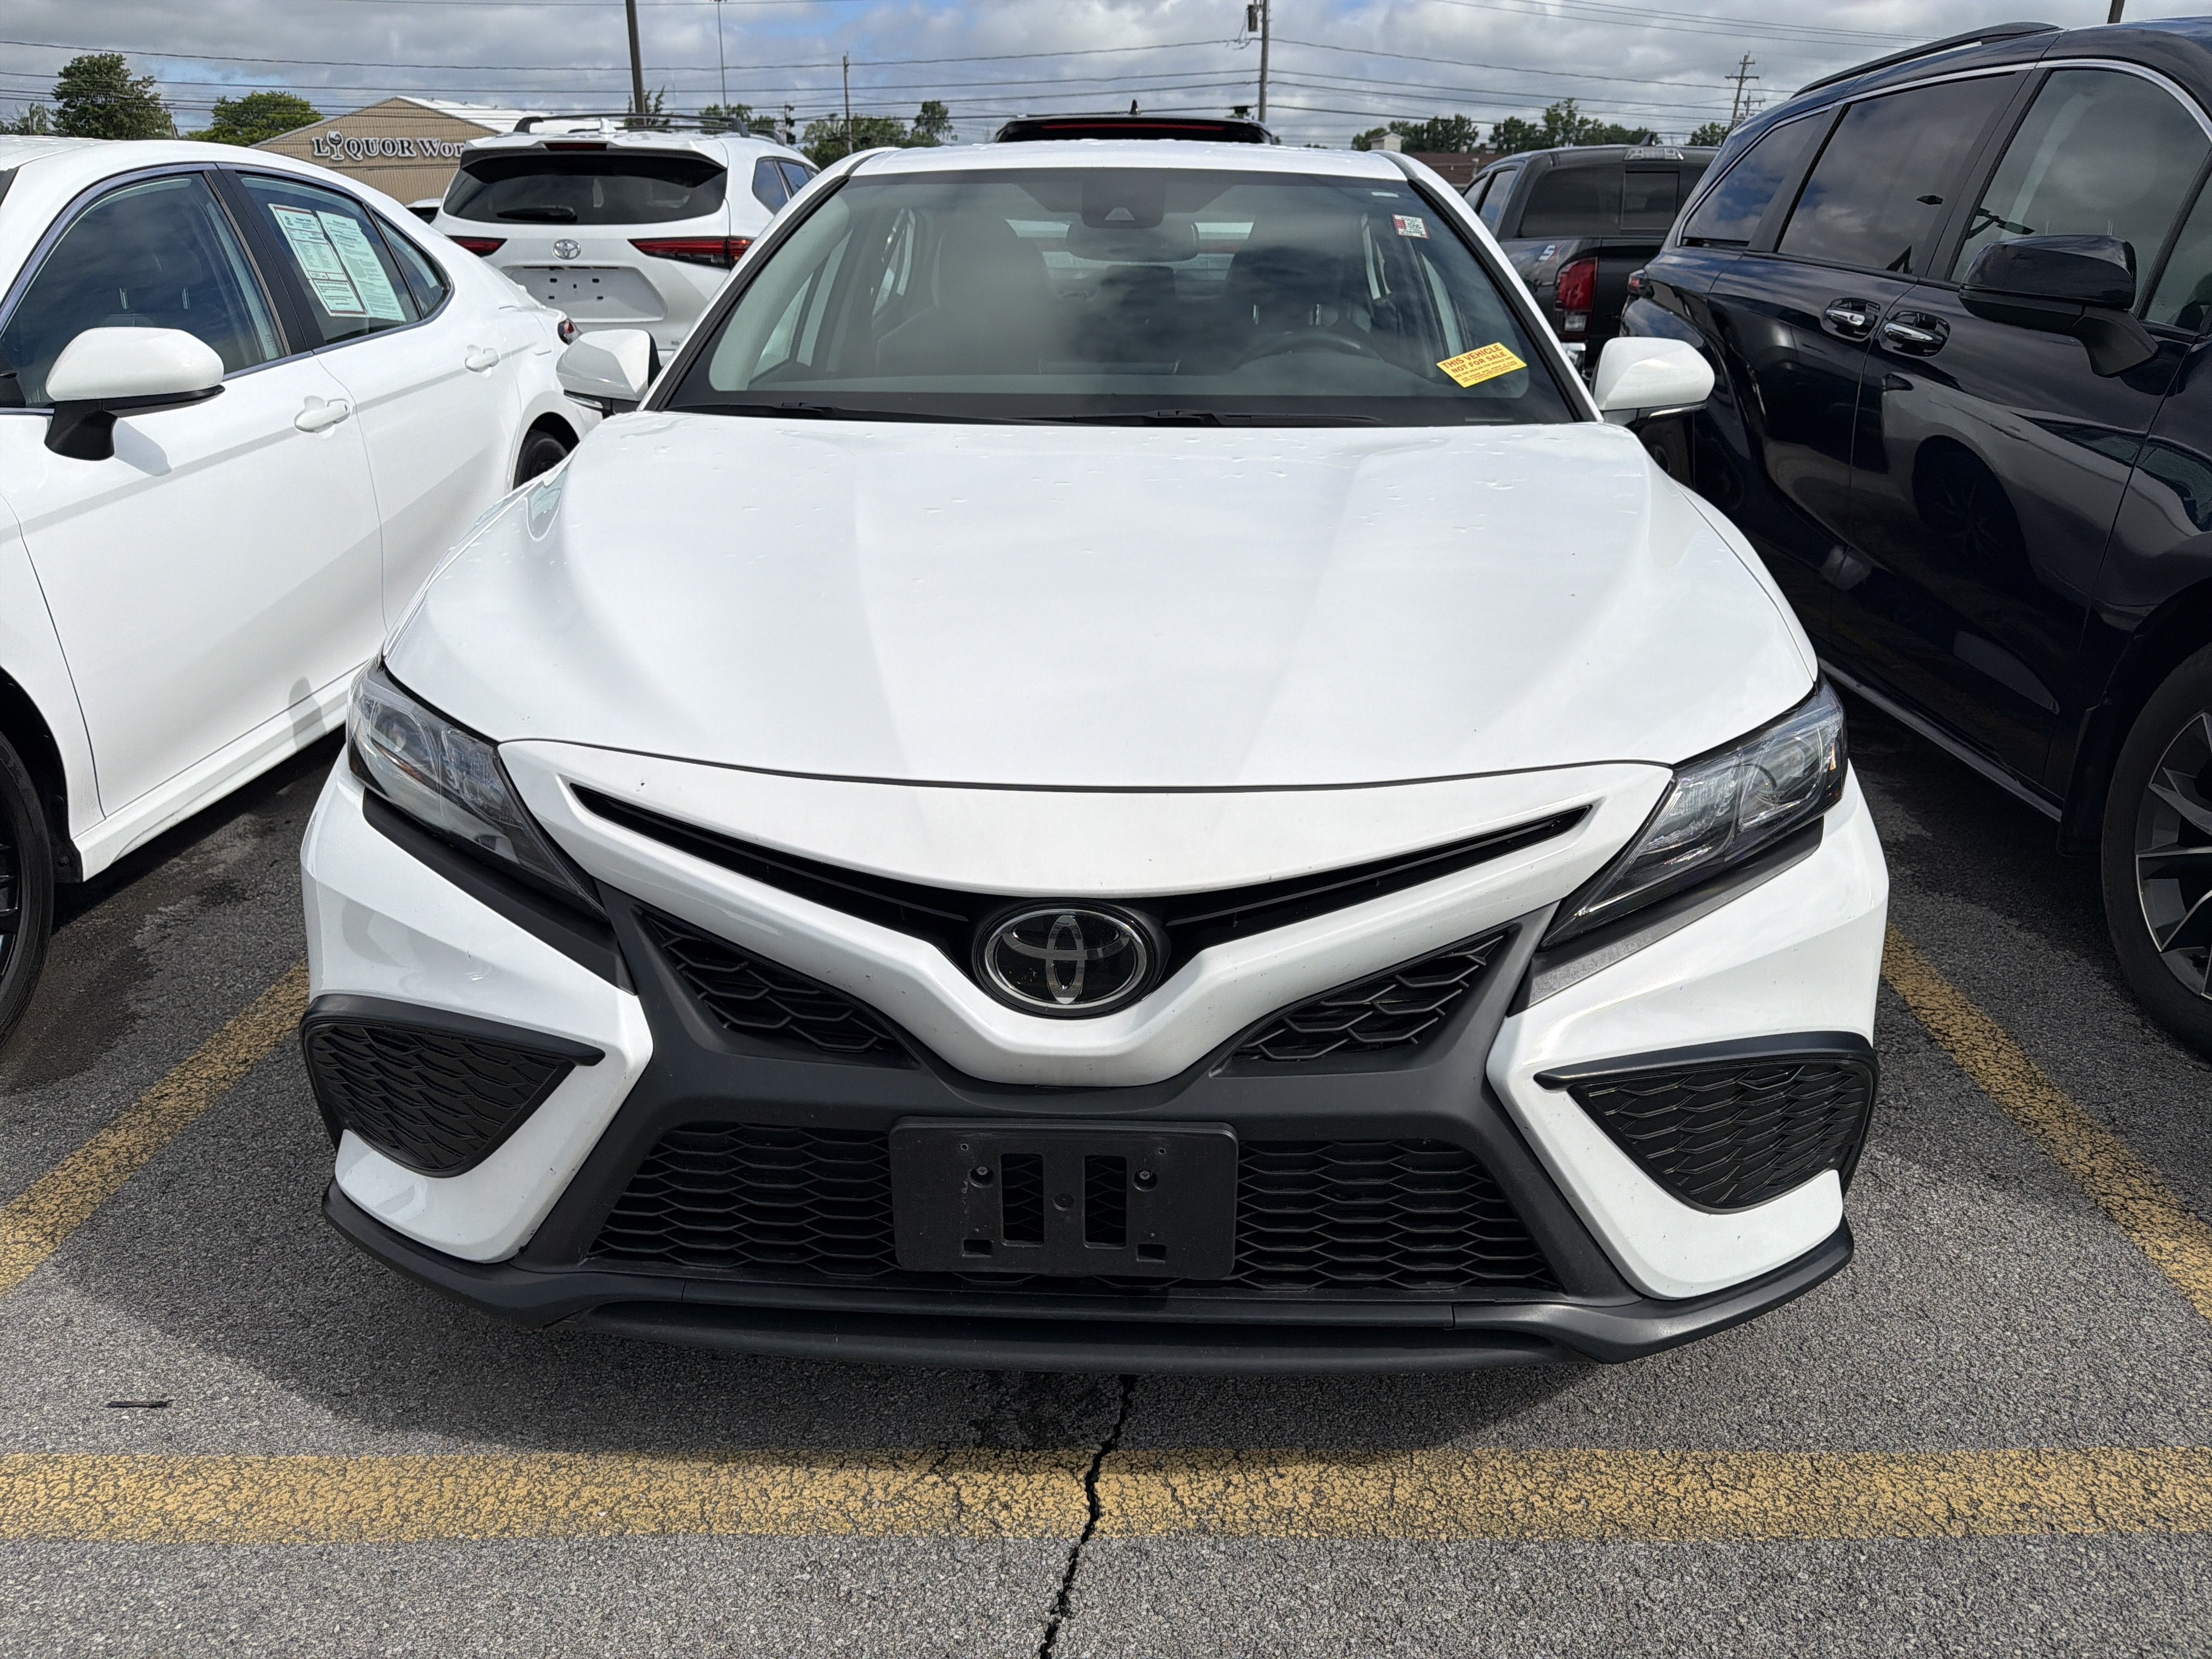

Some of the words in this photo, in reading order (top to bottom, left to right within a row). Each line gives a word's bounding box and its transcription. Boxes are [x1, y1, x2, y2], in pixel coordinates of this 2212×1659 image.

[1441, 358, 1464, 369] THIS
[1465, 345, 1503, 361] VEHICLE
[1451, 364, 1468, 374] NOT
[1468, 358, 1486, 368] FOR
[1486, 352, 1507, 362] SALE
